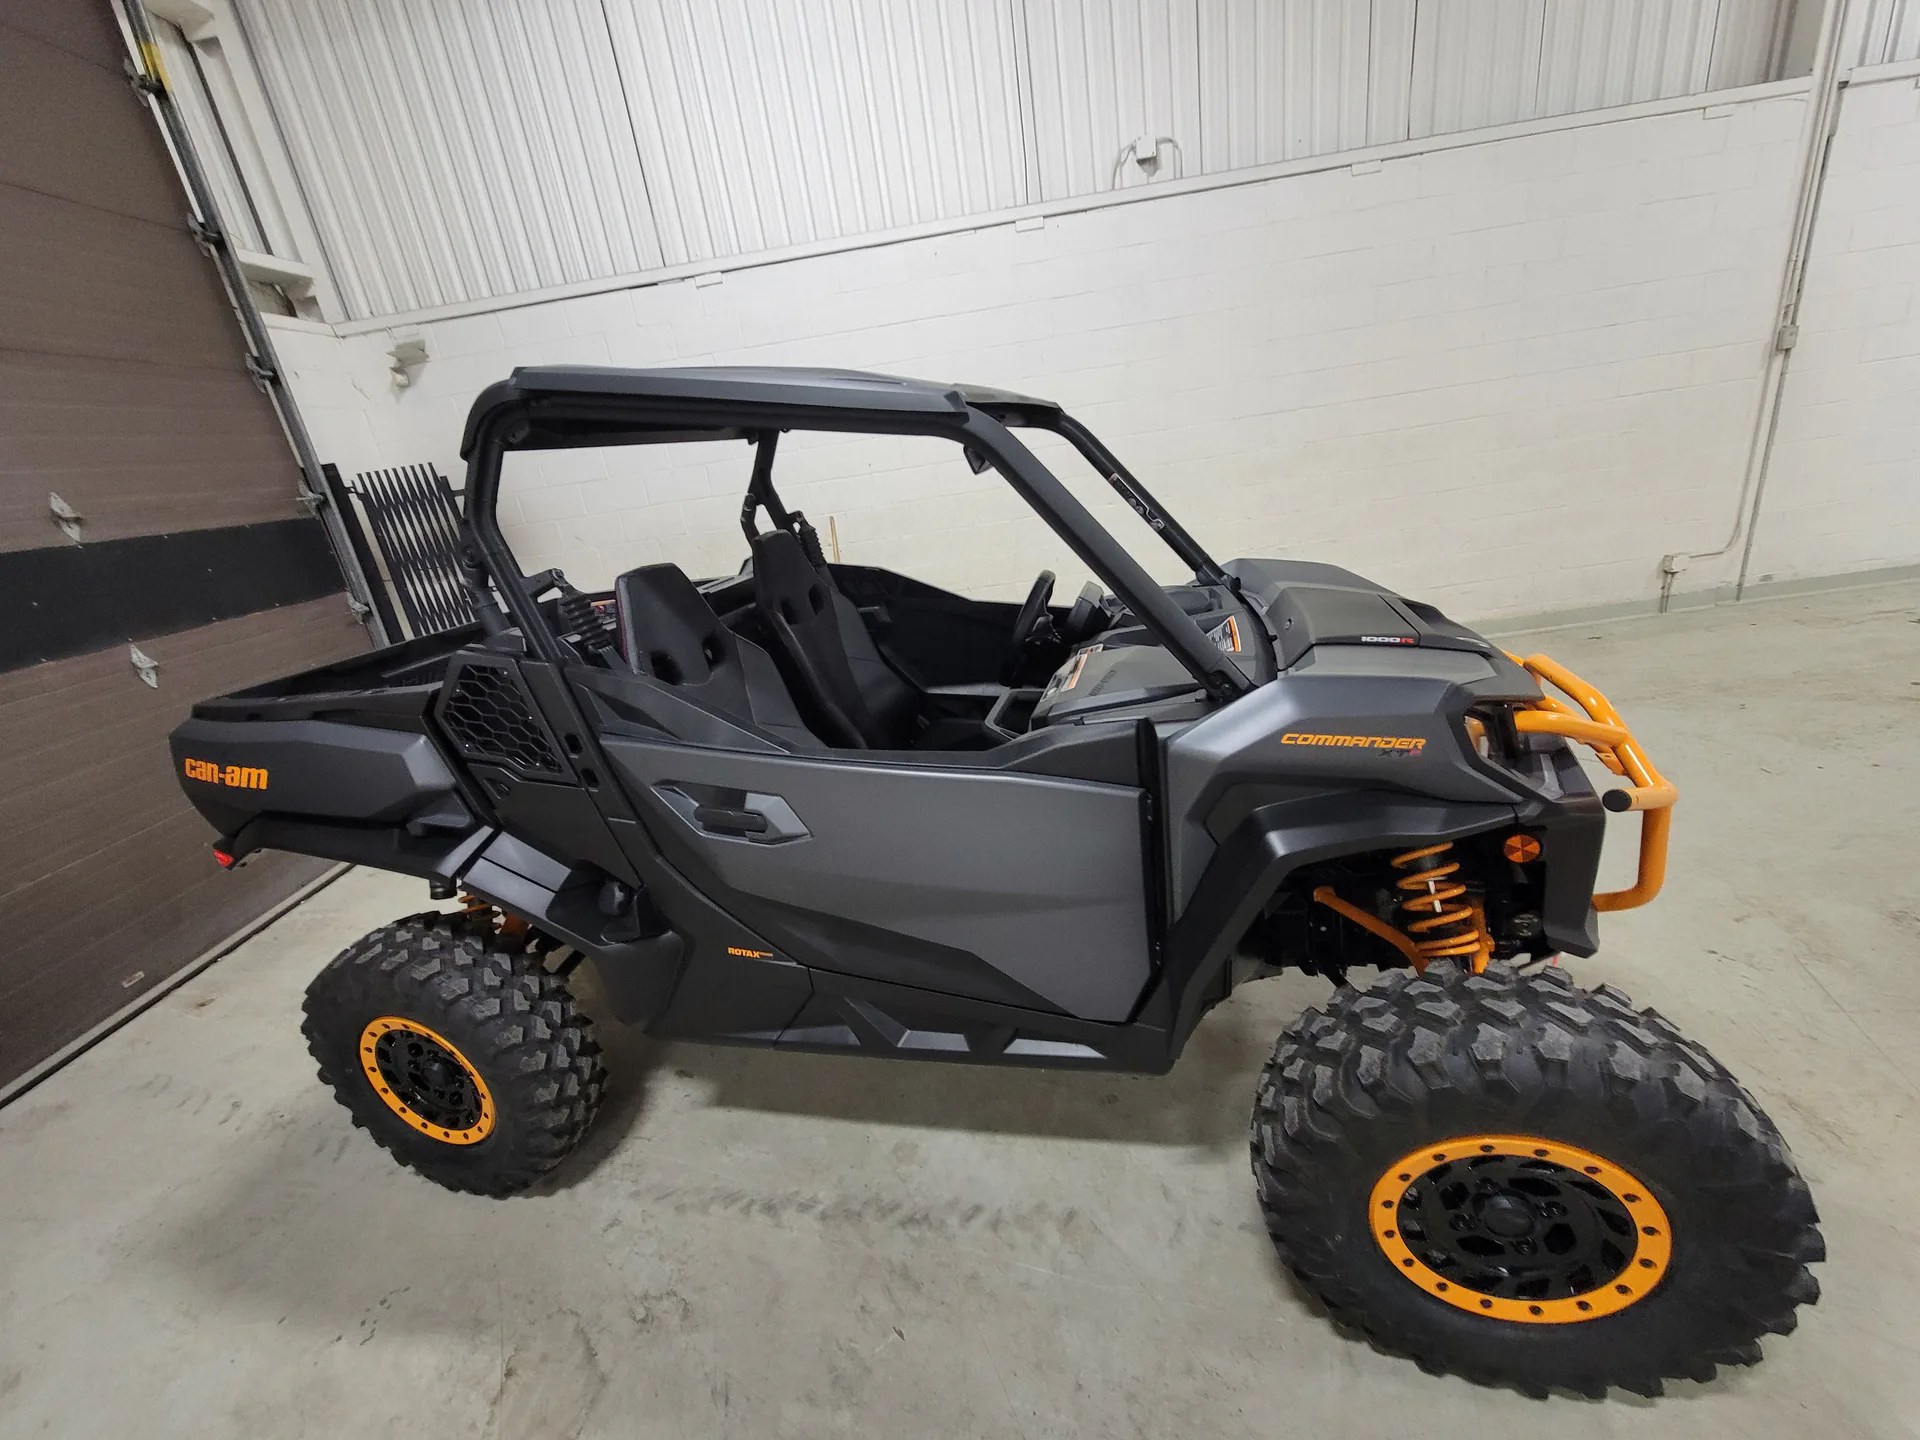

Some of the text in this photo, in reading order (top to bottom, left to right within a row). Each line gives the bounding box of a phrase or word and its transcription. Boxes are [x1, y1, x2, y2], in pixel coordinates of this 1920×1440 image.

[1361, 636, 1415, 644] 1000R
[1280, 733, 1427, 749] COMMANDER
[184, 757, 269, 790] can-am
[727, 947, 760, 958] ROTAX
